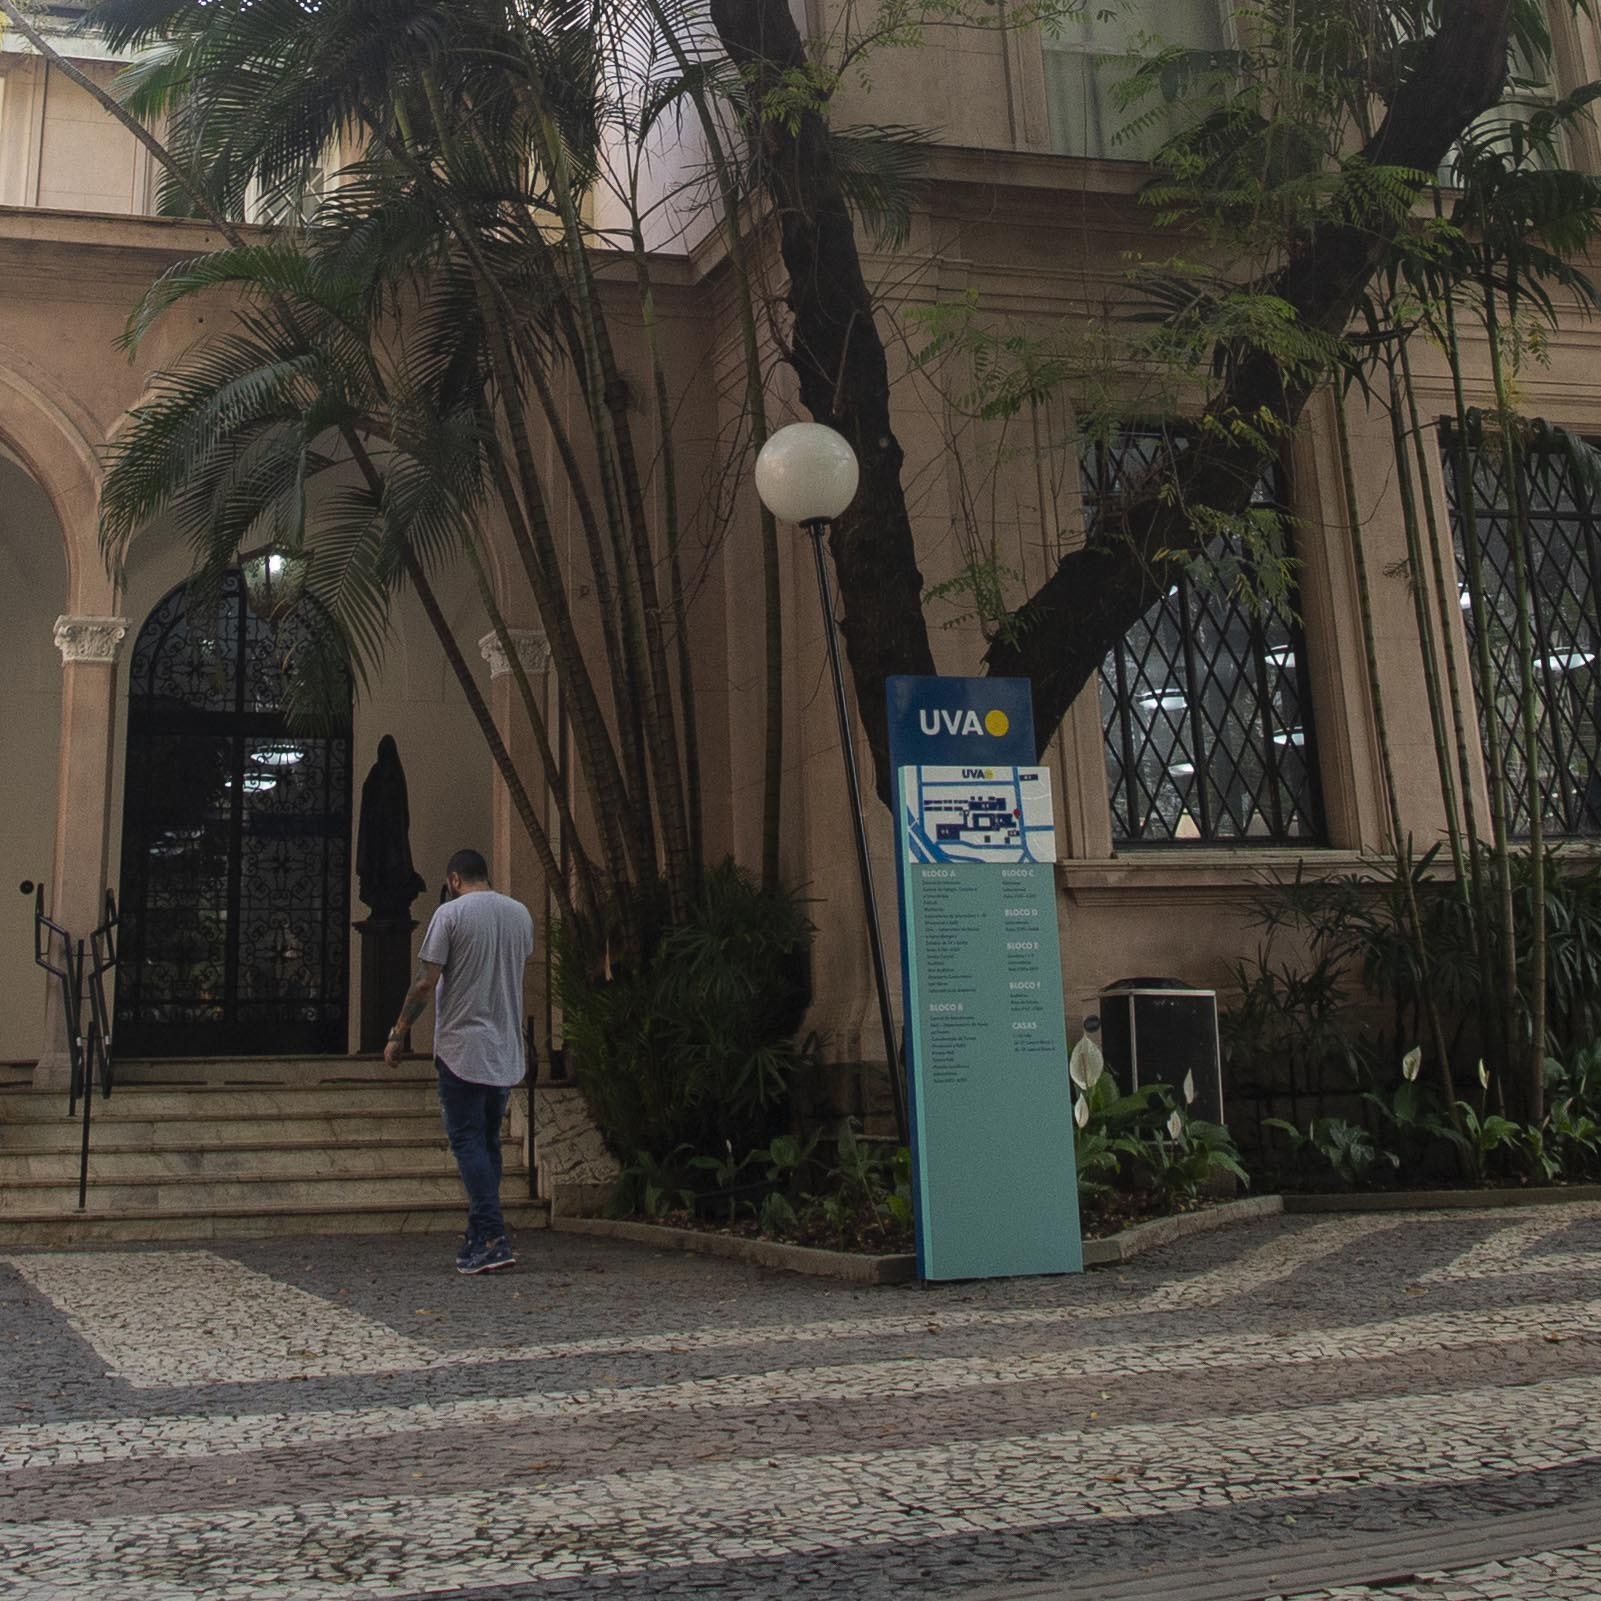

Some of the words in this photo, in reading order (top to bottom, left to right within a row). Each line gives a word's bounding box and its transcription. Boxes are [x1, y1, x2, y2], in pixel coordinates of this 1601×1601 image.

[919, 709, 984, 735] UVA
[962, 769, 985, 779] UVA
[921, 869, 949, 878] BLOCO
[1001, 869, 1028, 878] BLOCO
[1004, 908, 1031, 917] BLOCO
[1007, 942, 1033, 950] BLOCO
[1009, 981, 1036, 990] BLOCO
[929, 1003, 957, 1011] BLOCO
[1012, 1021, 1037, 1030] CASAS
